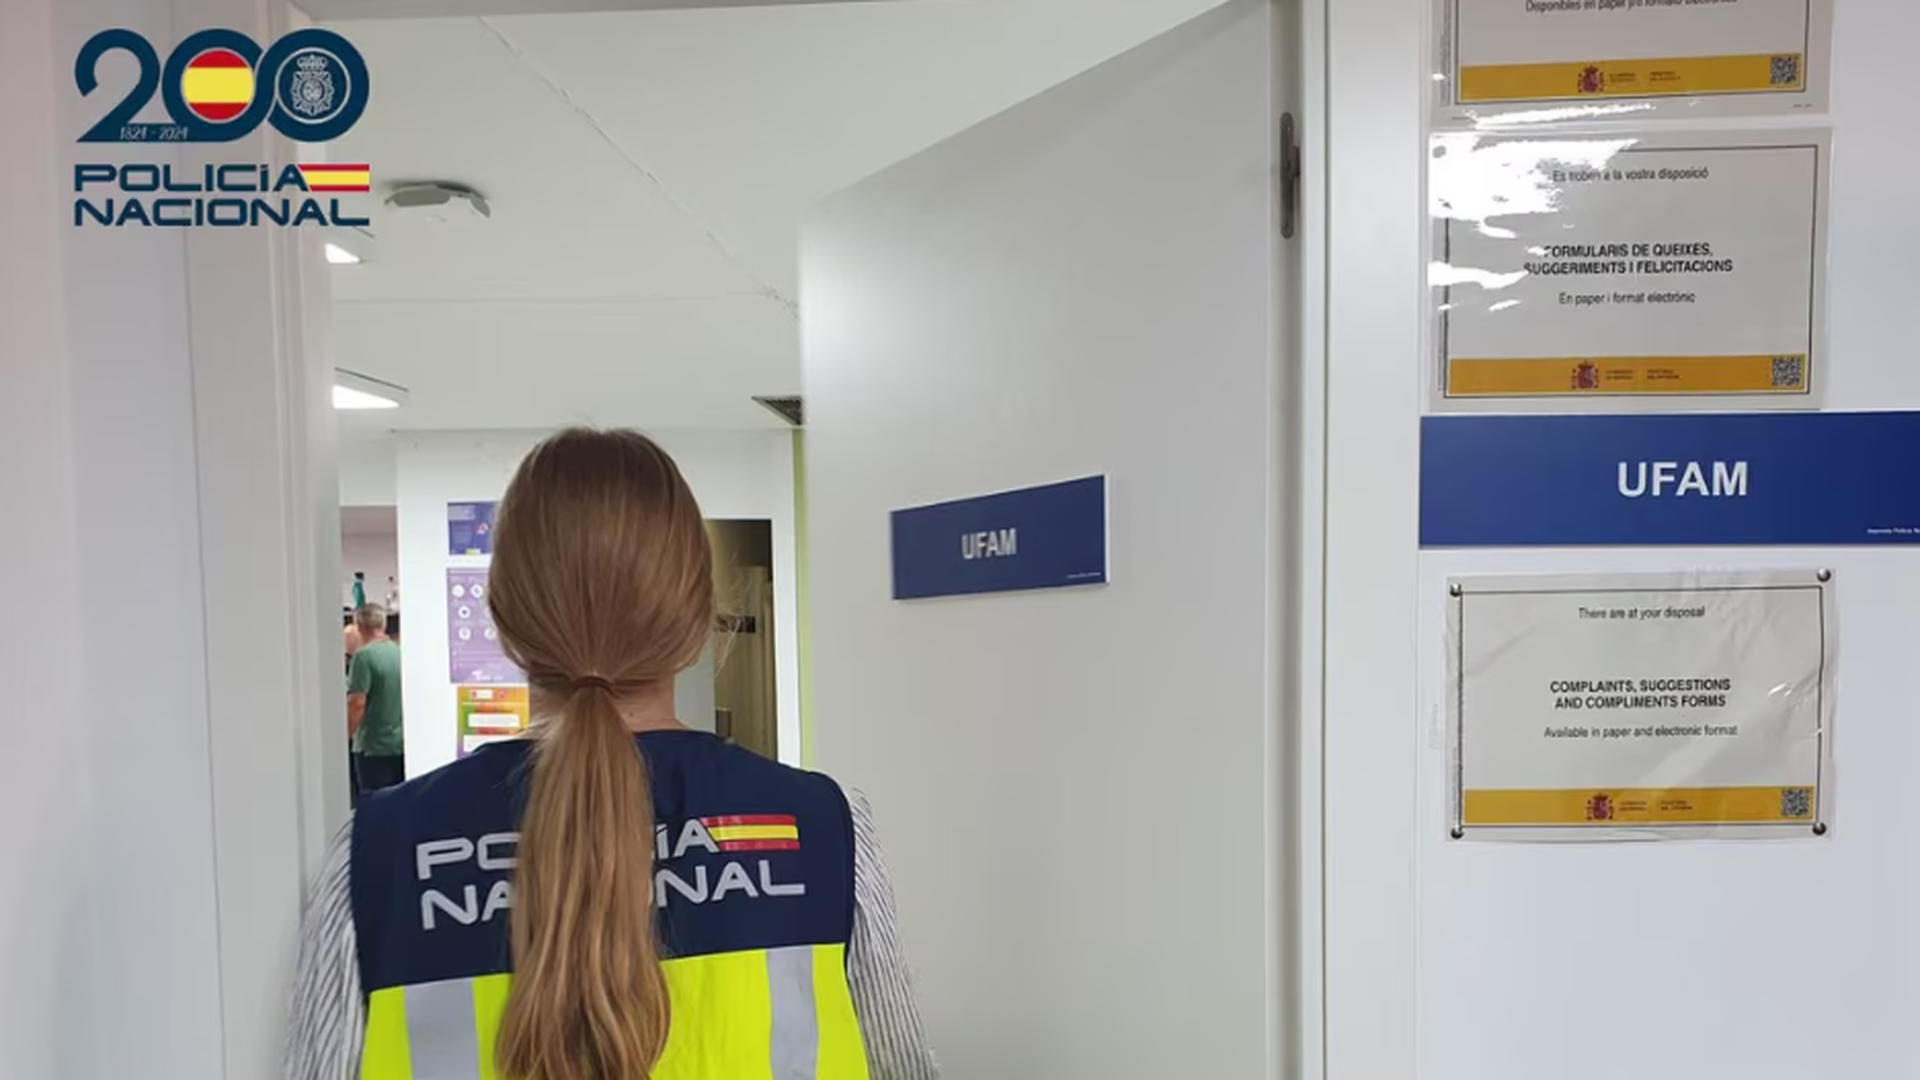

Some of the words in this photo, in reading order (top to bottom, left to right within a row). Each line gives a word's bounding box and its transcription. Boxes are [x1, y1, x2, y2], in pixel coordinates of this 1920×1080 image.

[1613, 168, 1622, 180] la
[1626, 168, 1656, 180] vostra
[1658, 166, 1710, 182] disposició
[1632, 244, 1650, 257] DE
[1653, 243, 1713, 257] QUEIXES,
[1524, 261, 1626, 275] SUGGERIMENTS
[1637, 259, 1733, 273] FELICITACIONS
[1559, 292, 1574, 304] En
[1575, 294, 1605, 306] paper
[1612, 292, 1645, 303] format
[1617, 461, 1749, 497] UFAM
[961, 528, 1017, 560] UFAM
[1579, 606, 1606, 619] There
[1610, 608, 1625, 619] are
[1628, 607, 1638, 618] at
[1641, 608, 1661, 621] your
[1664, 605, 1705, 620] disposal
[1550, 679, 1637, 693] COMPLAINTS,
[1640, 679, 1731, 692] SUGGESTIONS
[1555, 697, 1583, 709] AND
[1585, 695, 1678, 709] COMPLIMENTS
[1681, 694, 1726, 708] FORMS
[1544, 726, 1589, 738] Available
[1592, 727, 1600, 737] in
[1603, 728, 1631, 739] paper
[1633, 726, 1652, 737] and
[1655, 725, 1702, 737] electronic
[1704, 725, 1737, 736] format
[422, 860, 806, 930] NANAL
